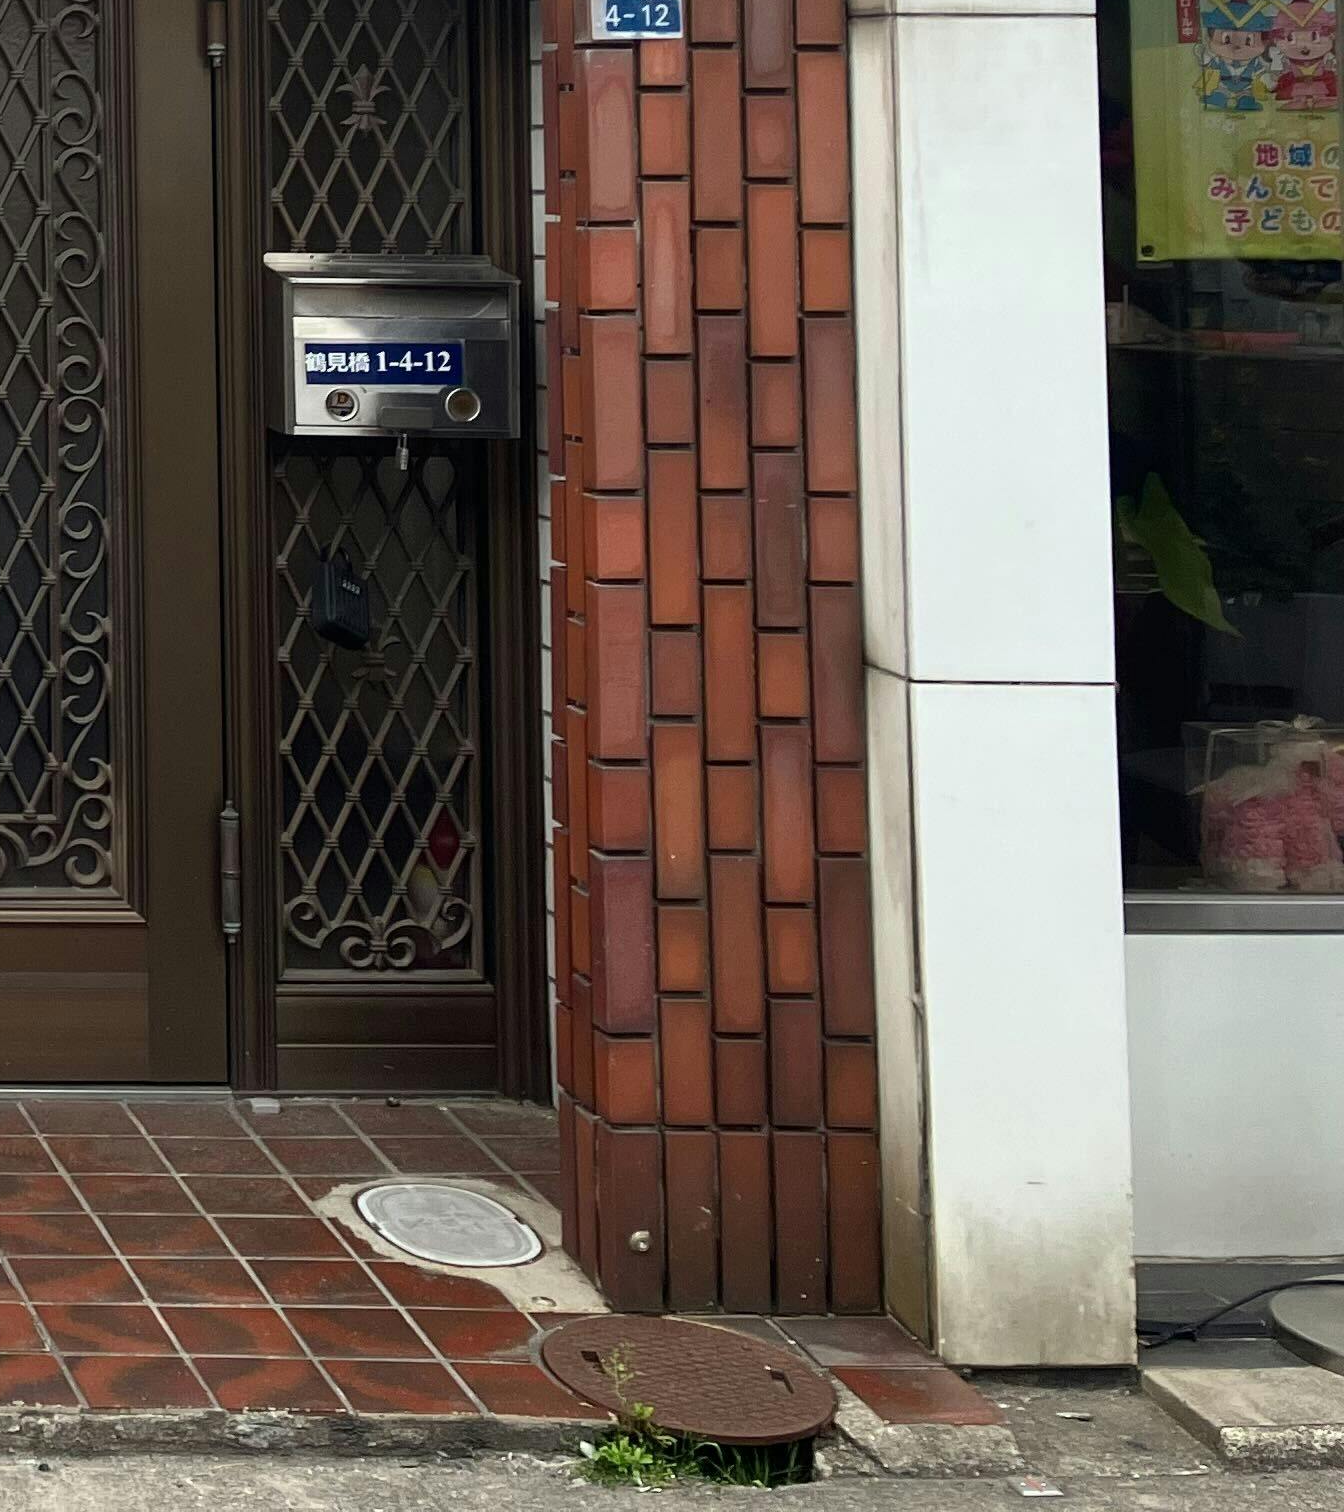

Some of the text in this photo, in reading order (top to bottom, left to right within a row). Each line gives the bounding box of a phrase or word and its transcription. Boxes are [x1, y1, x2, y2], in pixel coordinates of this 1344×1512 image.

[605, 4, 670, 27] 4-12
[1210, 176, 1335, 199] みんなで
[306, 351, 451, 373] 鶴見橋 1-4-12
